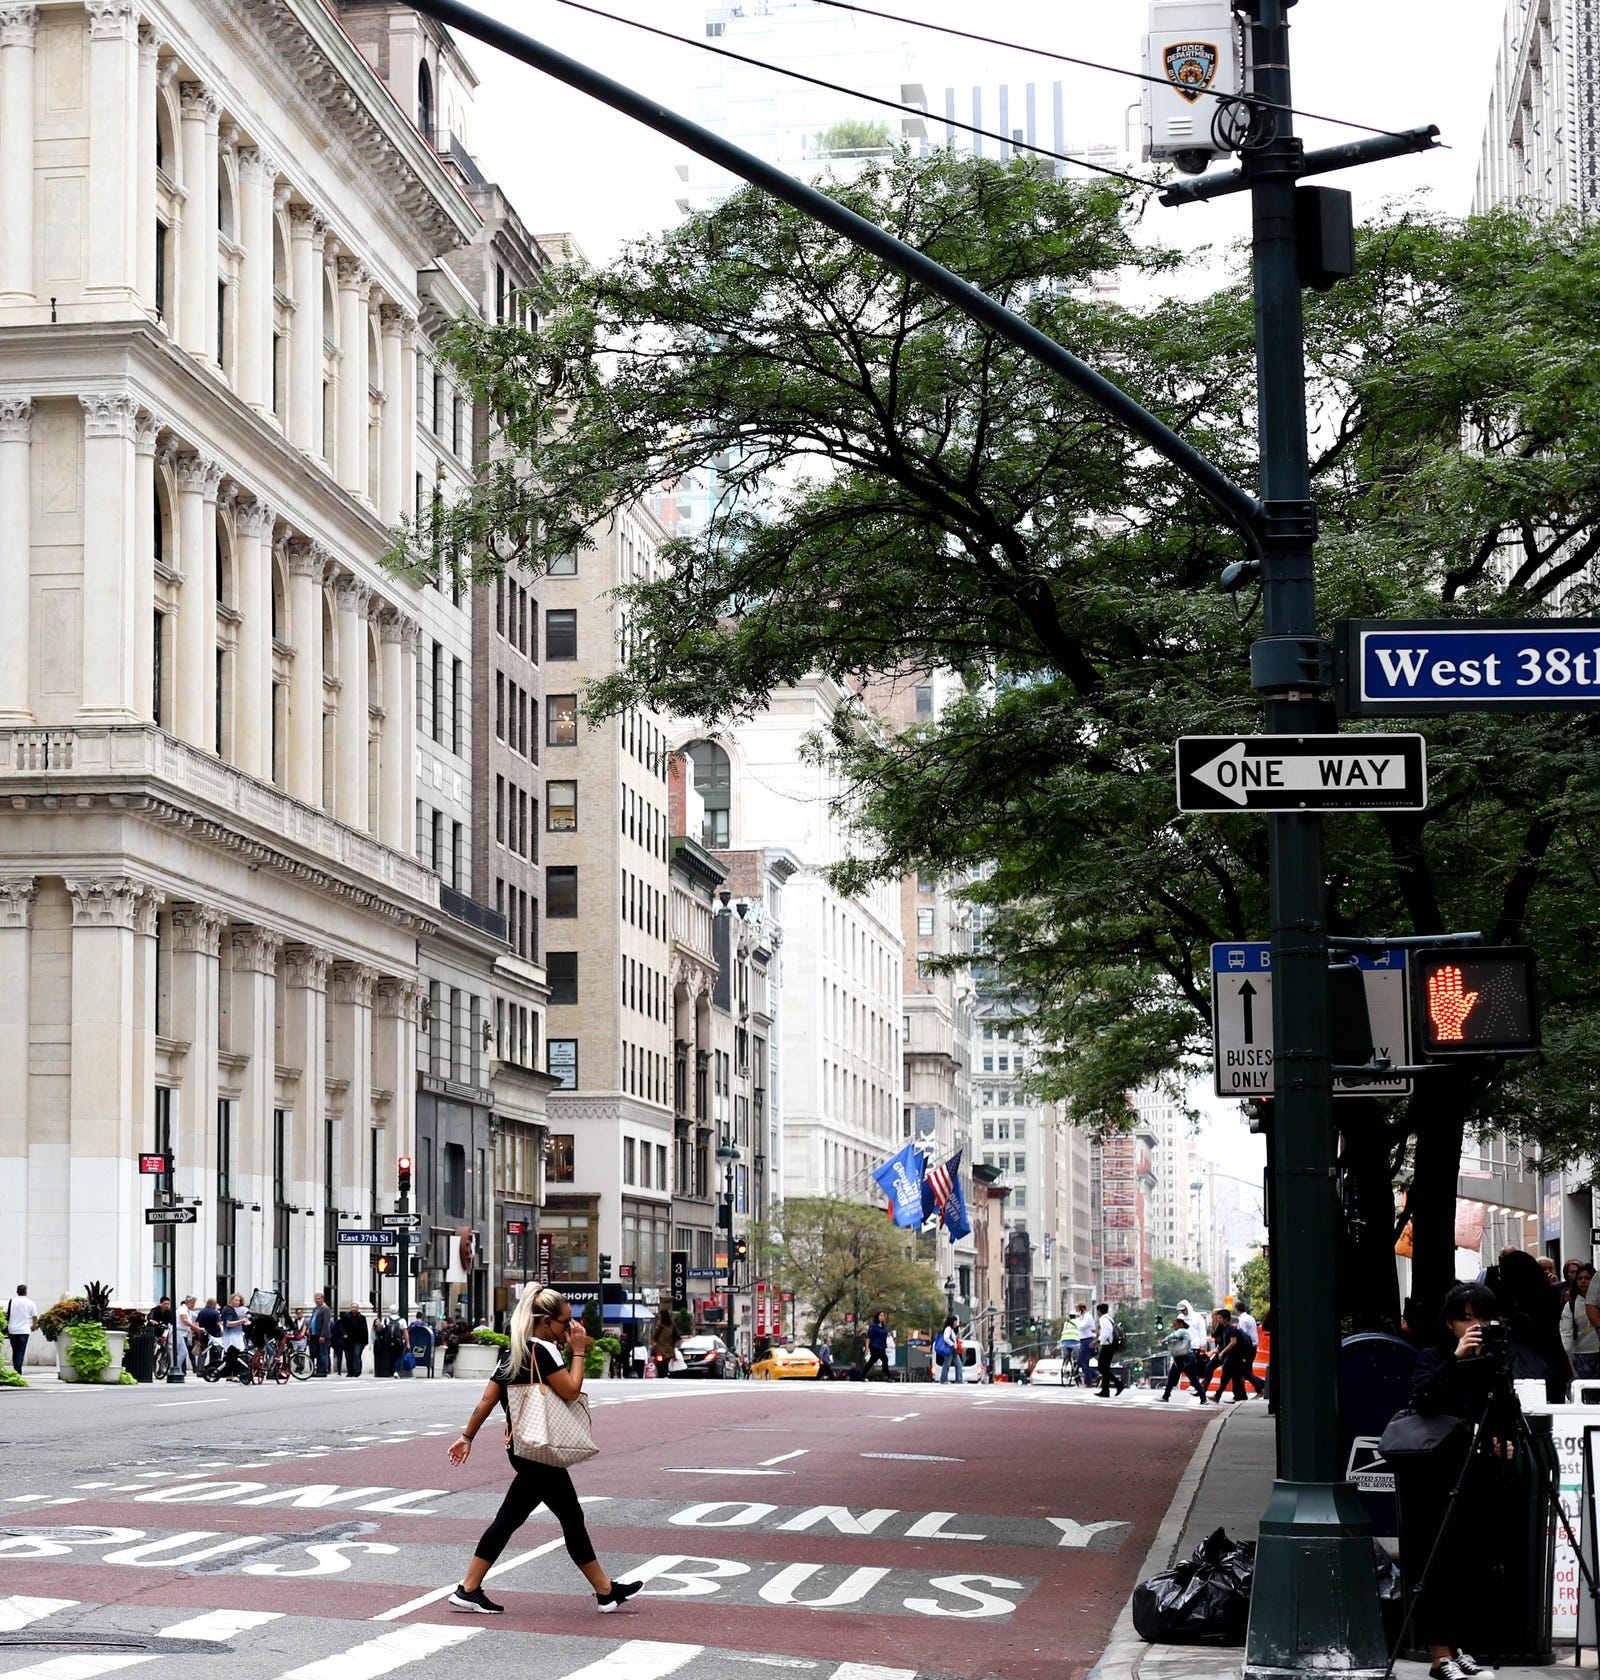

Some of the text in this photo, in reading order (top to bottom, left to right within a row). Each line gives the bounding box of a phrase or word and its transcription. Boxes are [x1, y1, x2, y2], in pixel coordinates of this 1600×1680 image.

[1166, 50, 1215, 63] DEPARTMENT
[1176, 44, 1205, 53] POLICE
[1374, 647, 1501, 688] West
[1216, 759, 1391, 787] ONE WAY
[1226, 1049, 1273, 1067] BUSES
[1231, 1071, 1269, 1088] ONLY
[152, 1212, 168, 1220] ONE
[340, 1233, 389, 1242] East 37th St
[562, 1292, 599, 1300] SHOPPE
[667, 1501, 1132, 1548] ONLY
[612, 1554, 1025, 1618] BUS
